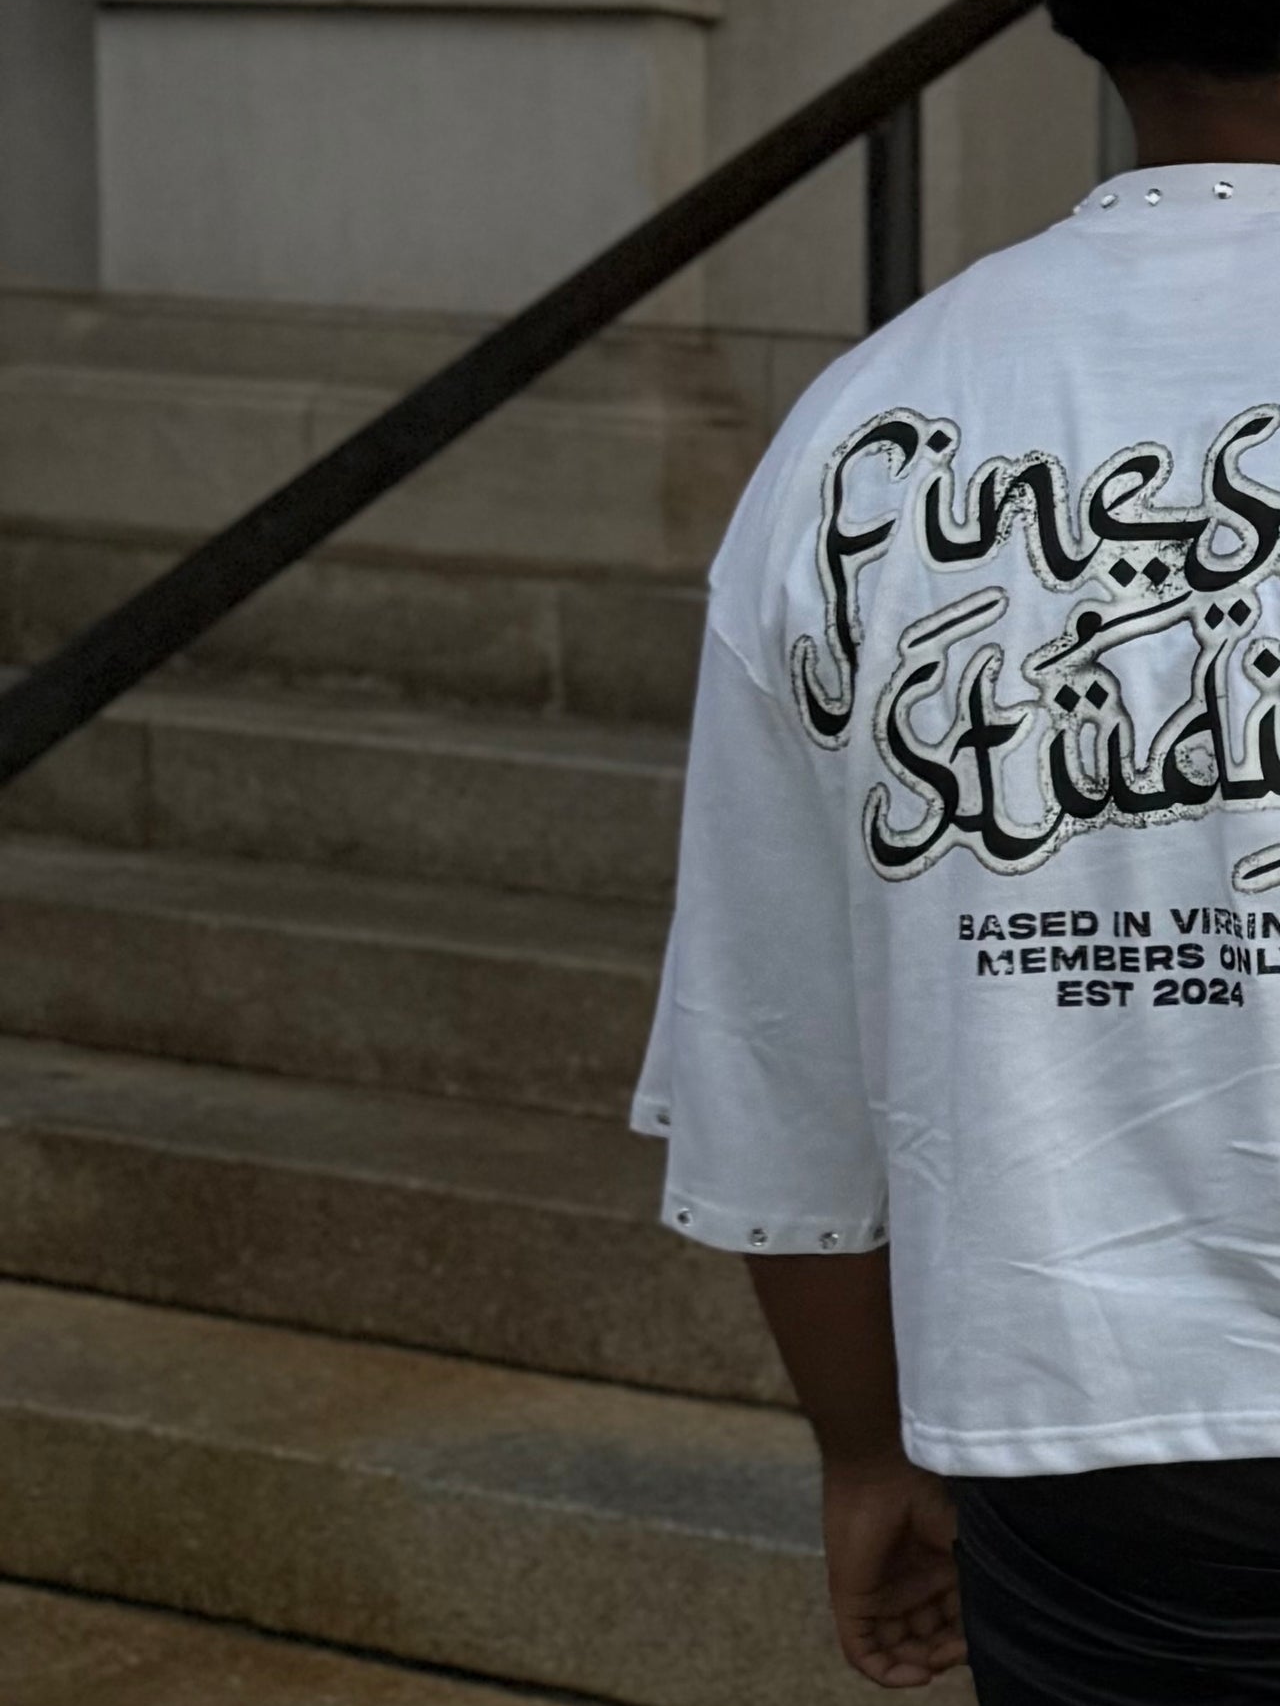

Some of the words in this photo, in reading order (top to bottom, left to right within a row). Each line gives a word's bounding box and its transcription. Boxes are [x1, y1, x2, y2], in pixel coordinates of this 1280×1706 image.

[958, 909, 1099, 941] BASED
[1112, 910, 1152, 939] IN
[976, 942, 1206, 976] MEMBERS
[1056, 979, 1134, 1008] EST
[1152, 977, 1245, 1008] 2024
